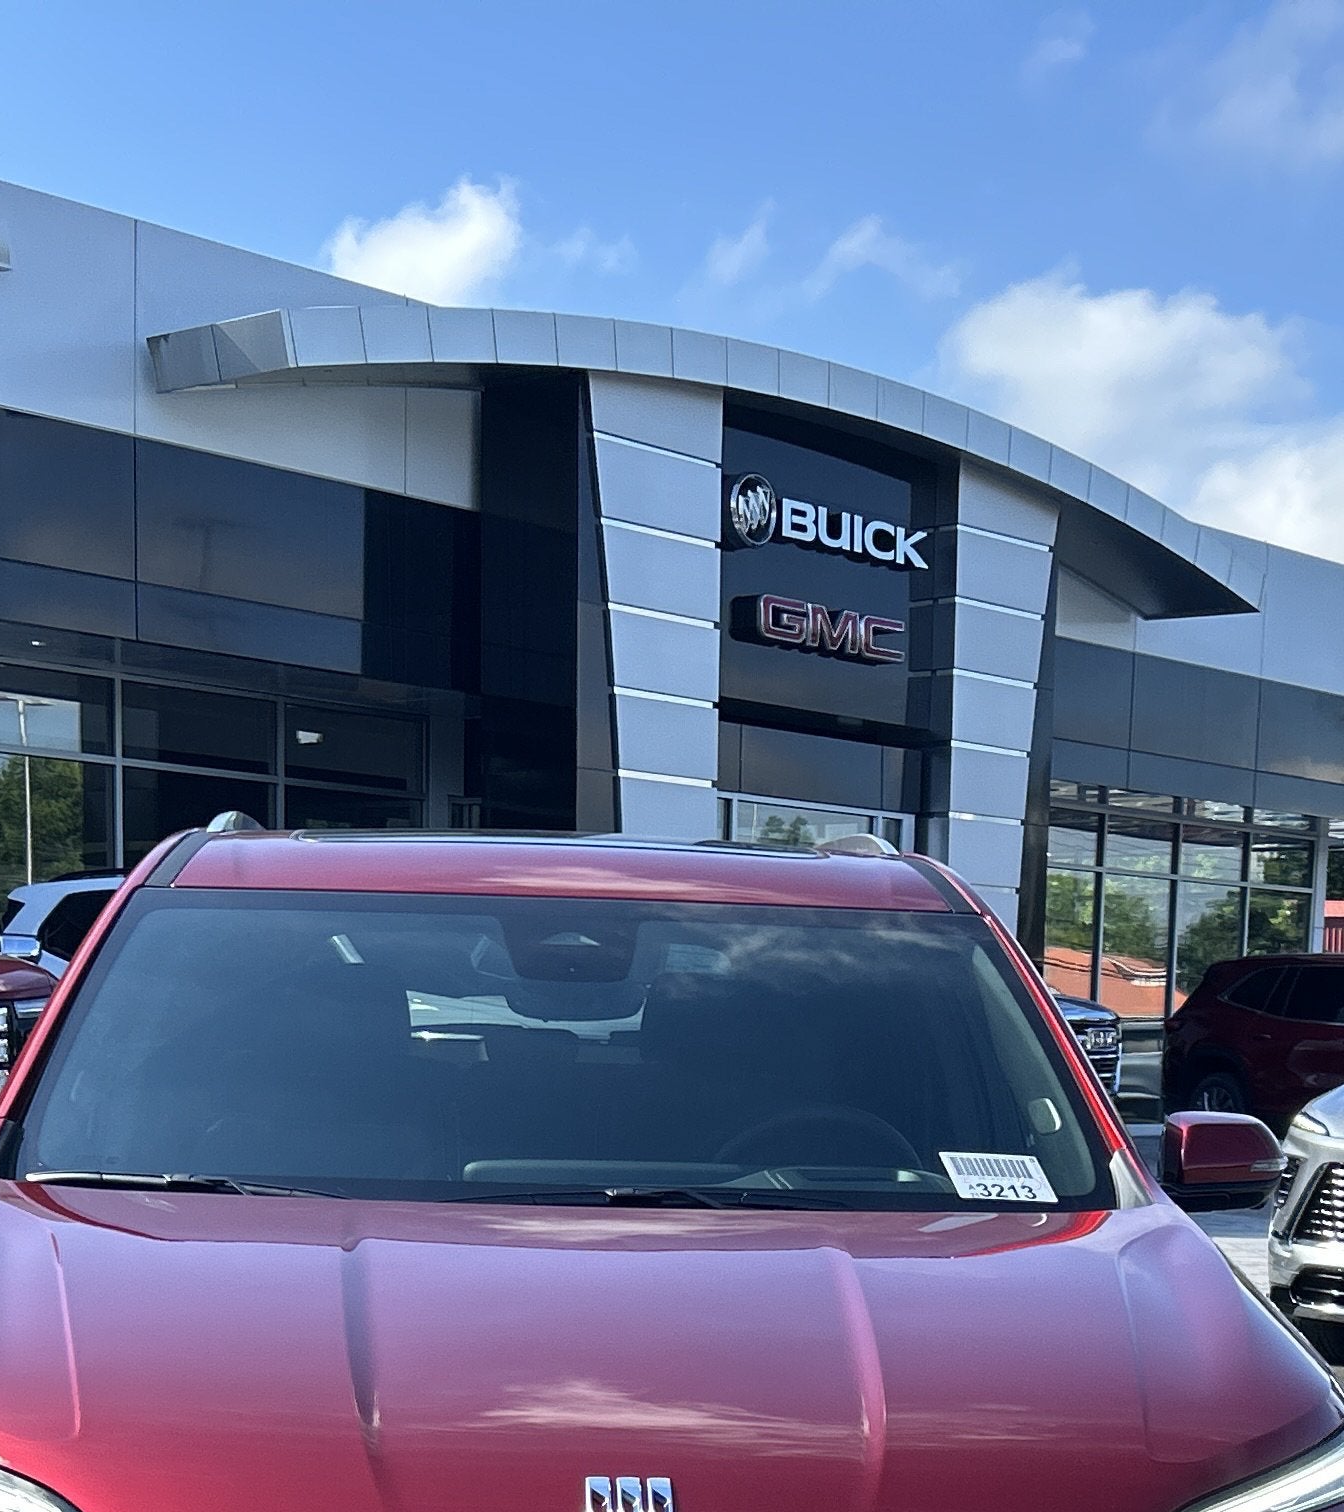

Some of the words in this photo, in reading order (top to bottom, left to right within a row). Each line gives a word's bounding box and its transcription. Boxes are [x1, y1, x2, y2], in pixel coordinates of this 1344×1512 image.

[781, 497, 929, 570] BUICK
[760, 593, 905, 663] GMC
[975, 1182, 1037, 1200] 3213
